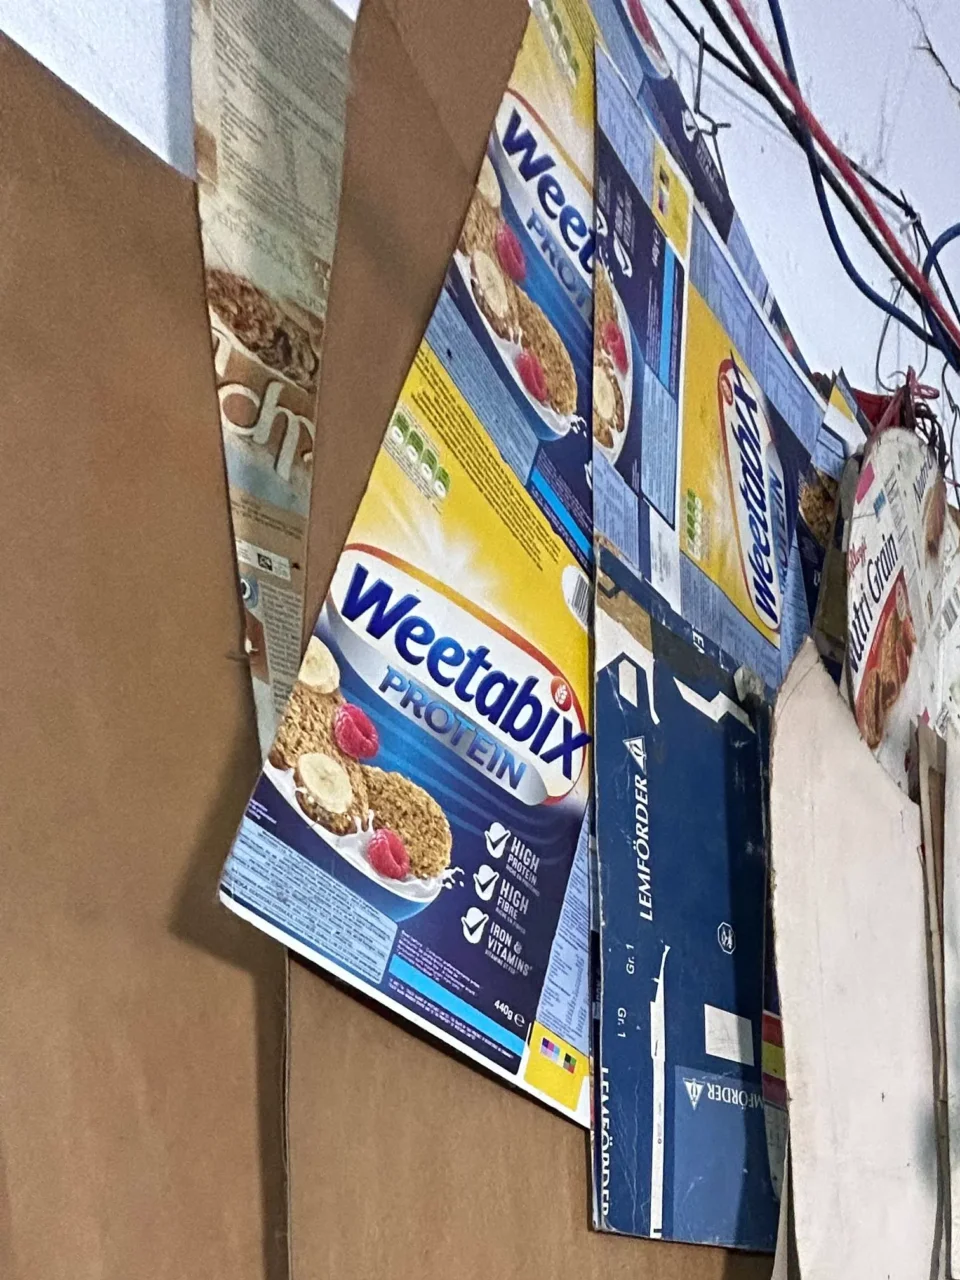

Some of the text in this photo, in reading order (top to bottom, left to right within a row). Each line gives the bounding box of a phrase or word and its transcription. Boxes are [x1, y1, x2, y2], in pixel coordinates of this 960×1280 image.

[730, 348, 778, 624] Weetabix
[867, 534, 898, 603] Grain
[341, 562, 593, 780] Weetabix
[378, 665, 527, 790] PROTEIN
[511, 837, 540, 873] HIGH
[632, 773, 653, 921] LEMFÖRDER
[507, 855, 537, 886] PROTEIN
[497, 897, 518, 920] FIBRE
[500, 879, 529, 915] HIGH
[490, 922, 511, 947] IRON
[626, 954, 635, 975] Gr.
[494, 1000, 514, 1020] 440g
[617, 1007, 627, 1026] Gr.
